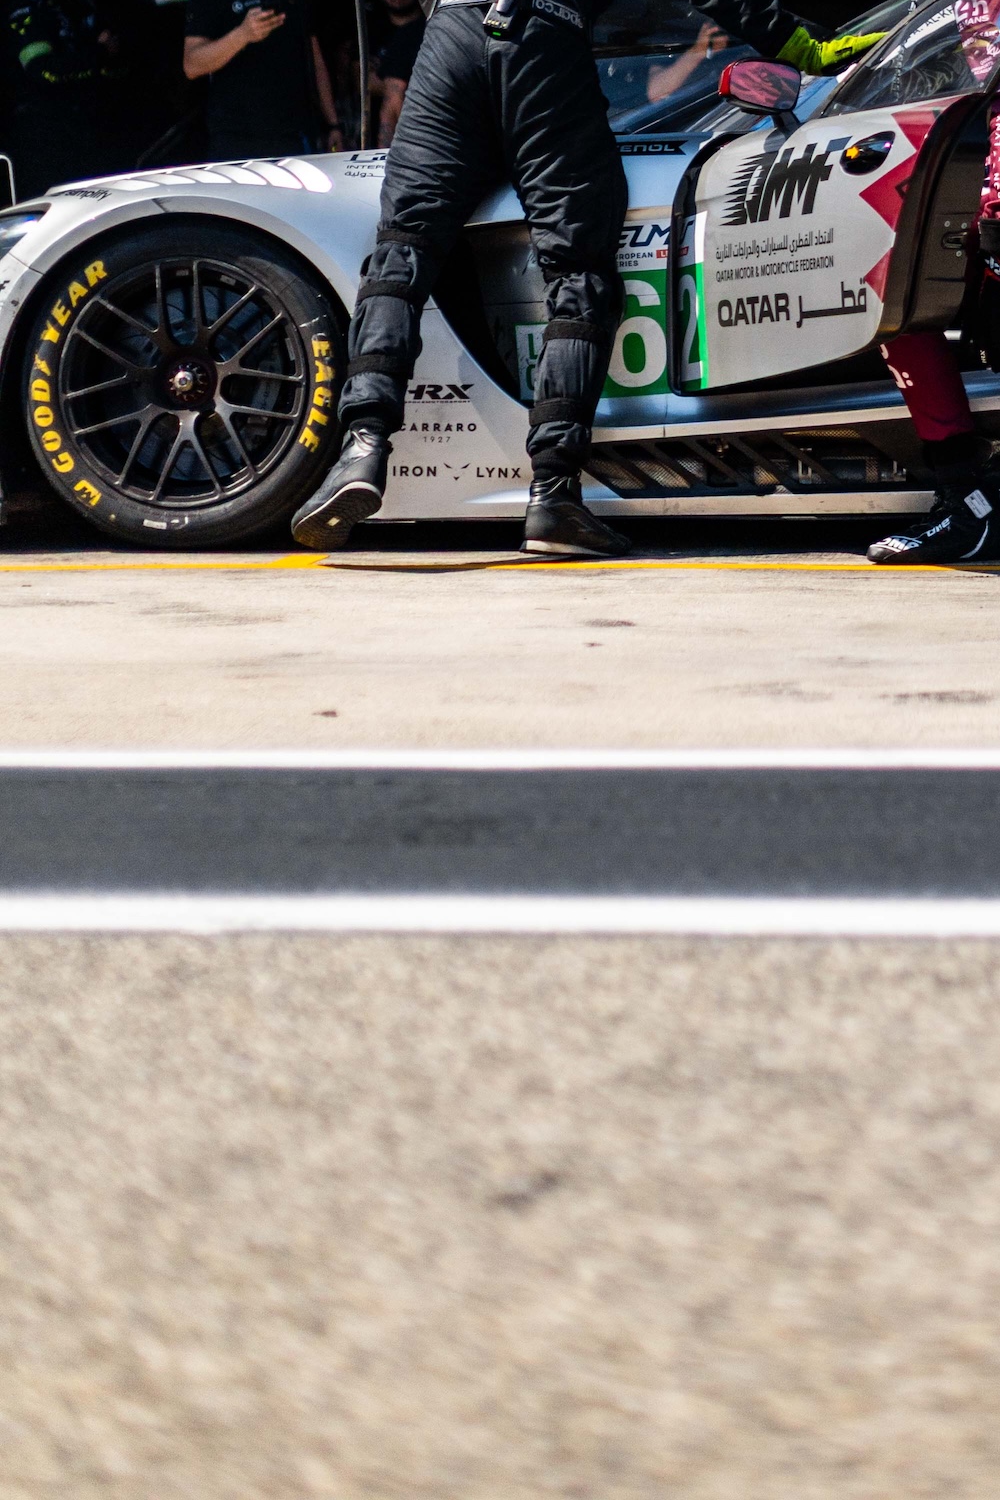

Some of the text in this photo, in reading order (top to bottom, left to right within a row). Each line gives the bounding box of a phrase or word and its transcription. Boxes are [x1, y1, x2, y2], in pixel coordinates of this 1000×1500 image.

[716, 255, 834, 282] QATAR MOTOR & MOTORCYCLE FEDERATION
[41, 260, 108, 343] YEAR
[717, 293, 790, 327] QATAR
[796, 278, 867, 328] قطر
[299, 339, 336, 453] EAGLE
[31, 379, 75, 473] GOOD
[400, 423, 477, 432] CARRARO
[393, 466, 521, 478] IRON LYNX
